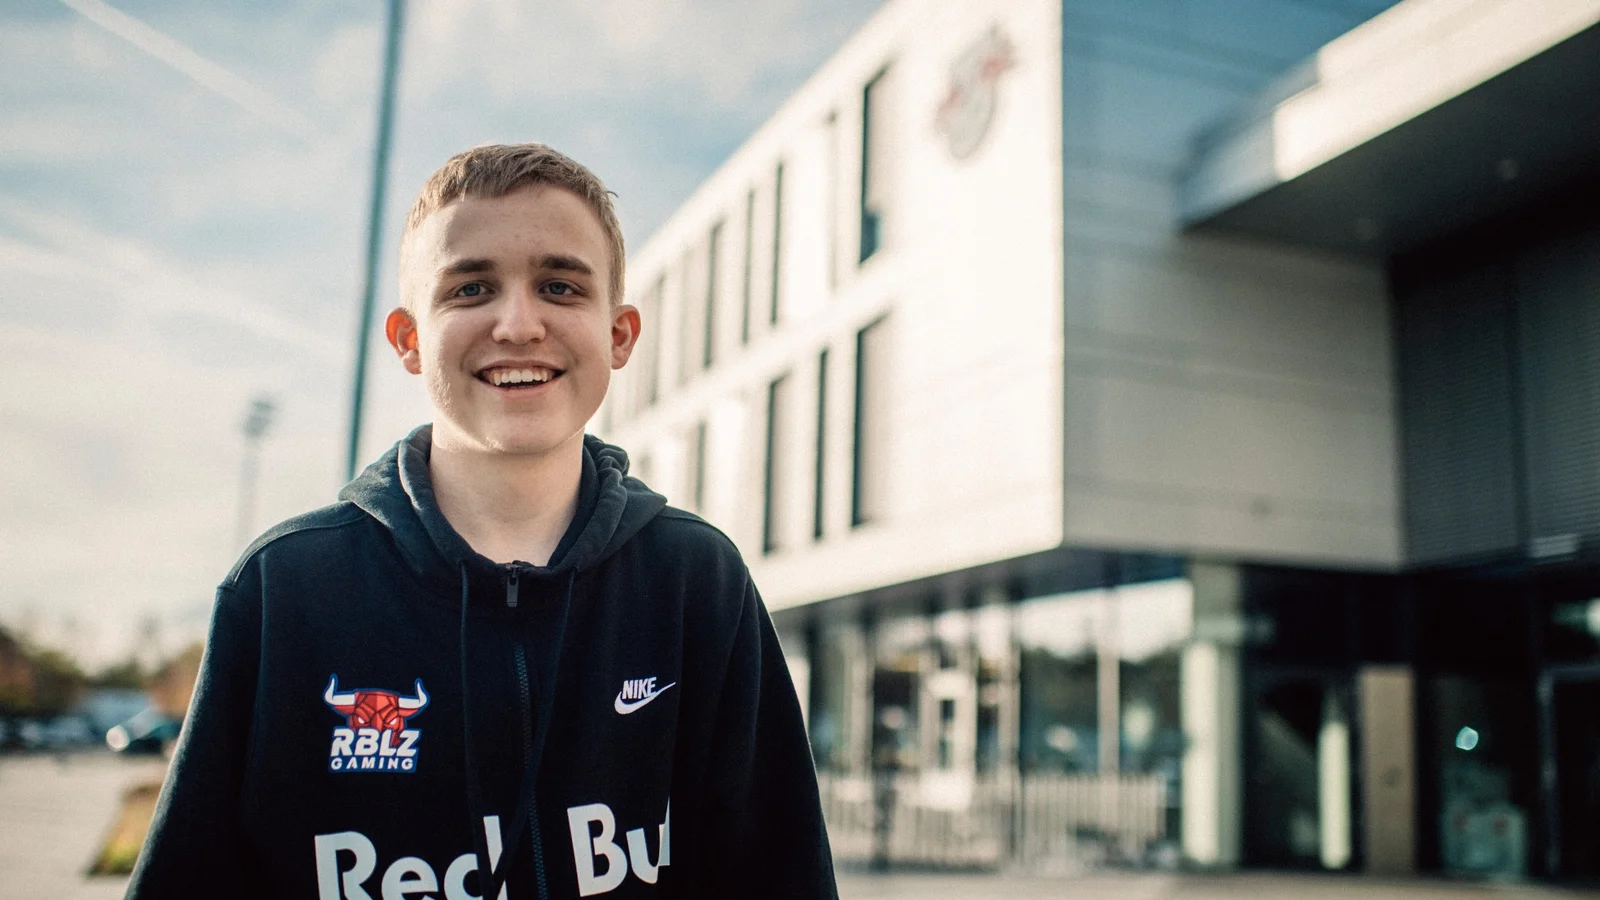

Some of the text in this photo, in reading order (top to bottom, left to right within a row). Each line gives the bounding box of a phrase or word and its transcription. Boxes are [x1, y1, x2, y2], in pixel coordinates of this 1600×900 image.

[621, 676, 657, 700] NIKE
[330, 728, 420, 757] RBLZ
[330, 757, 414, 770] GAMING
